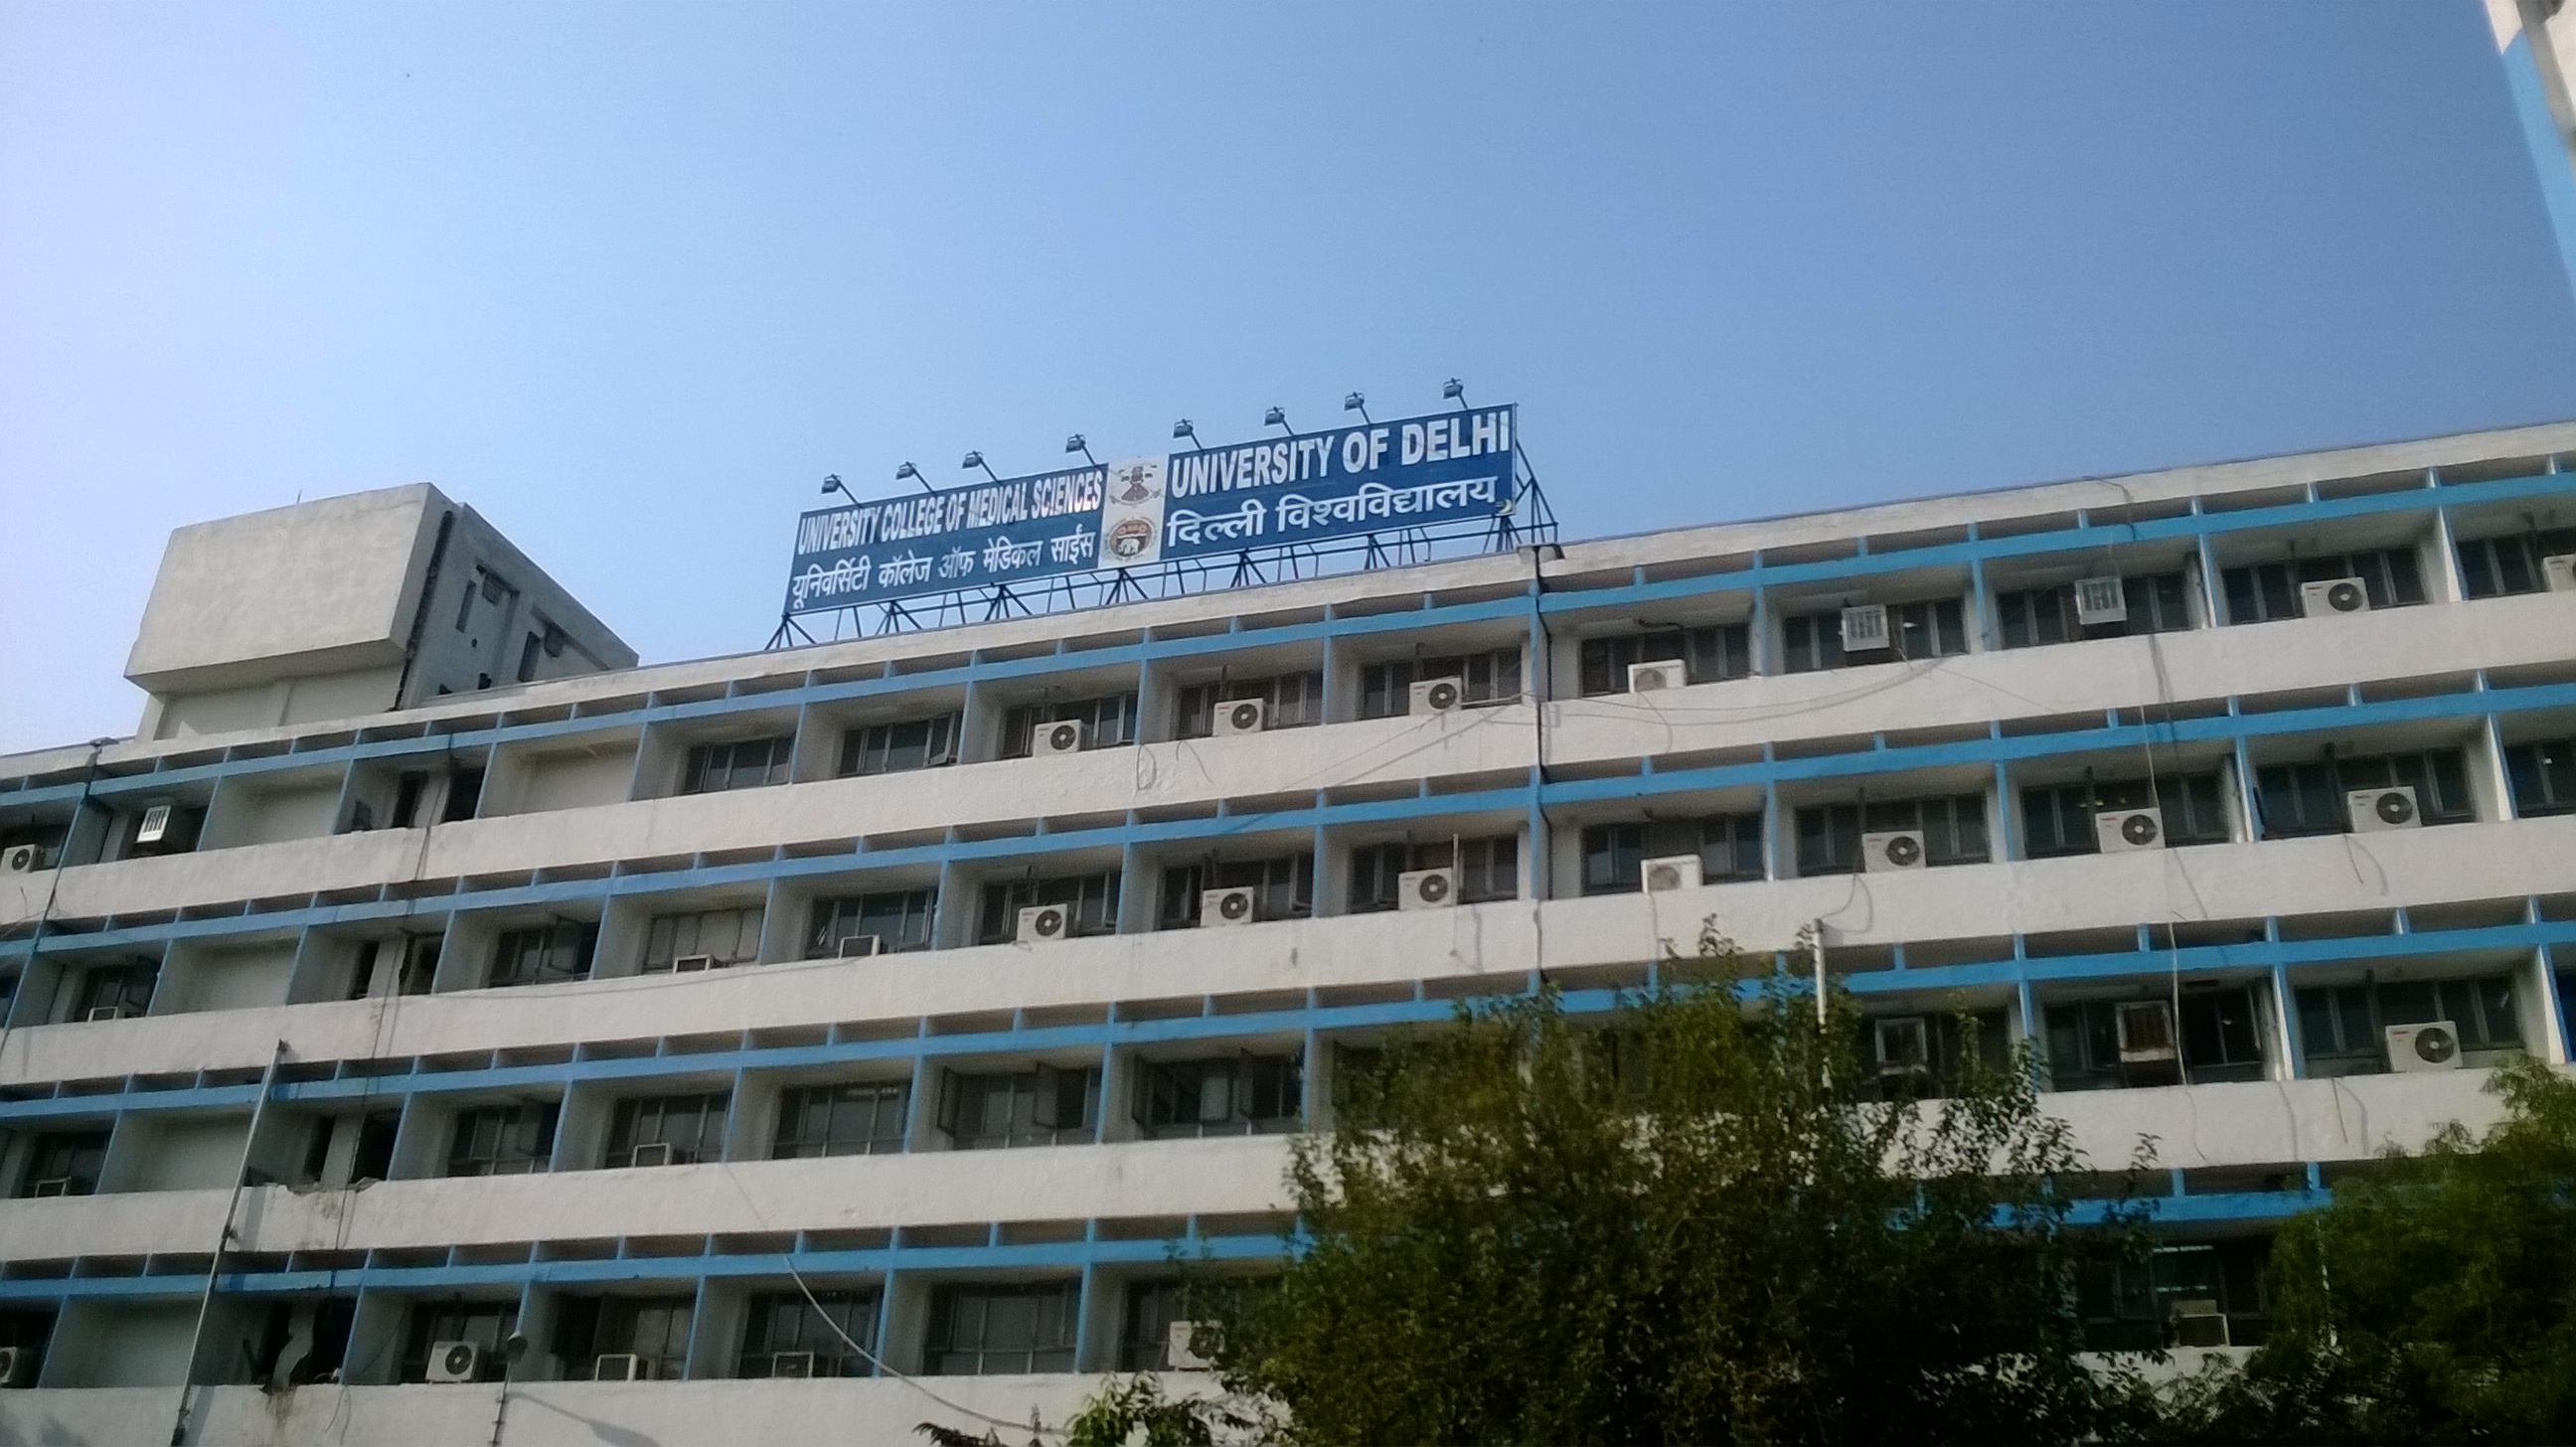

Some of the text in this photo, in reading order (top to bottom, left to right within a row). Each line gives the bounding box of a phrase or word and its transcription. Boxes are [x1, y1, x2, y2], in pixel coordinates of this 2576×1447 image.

[1171, 409, 1510, 499] UNIVERSITY OF DELHI
[797, 470, 1104, 556] UNIVERSITY COLLEGE OF MEDICAL SCIENCES
[1167, 498, 1267, 549] दिल्ली
[1275, 475, 1499, 533] विश्वविद्यालय
[792, 554, 873, 610] यूनिवर्सिटी
[878, 548, 935, 589] कॉलेज
[937, 546, 977, 579] ऑफ
[981, 535, 1045, 574] मेडिकल
